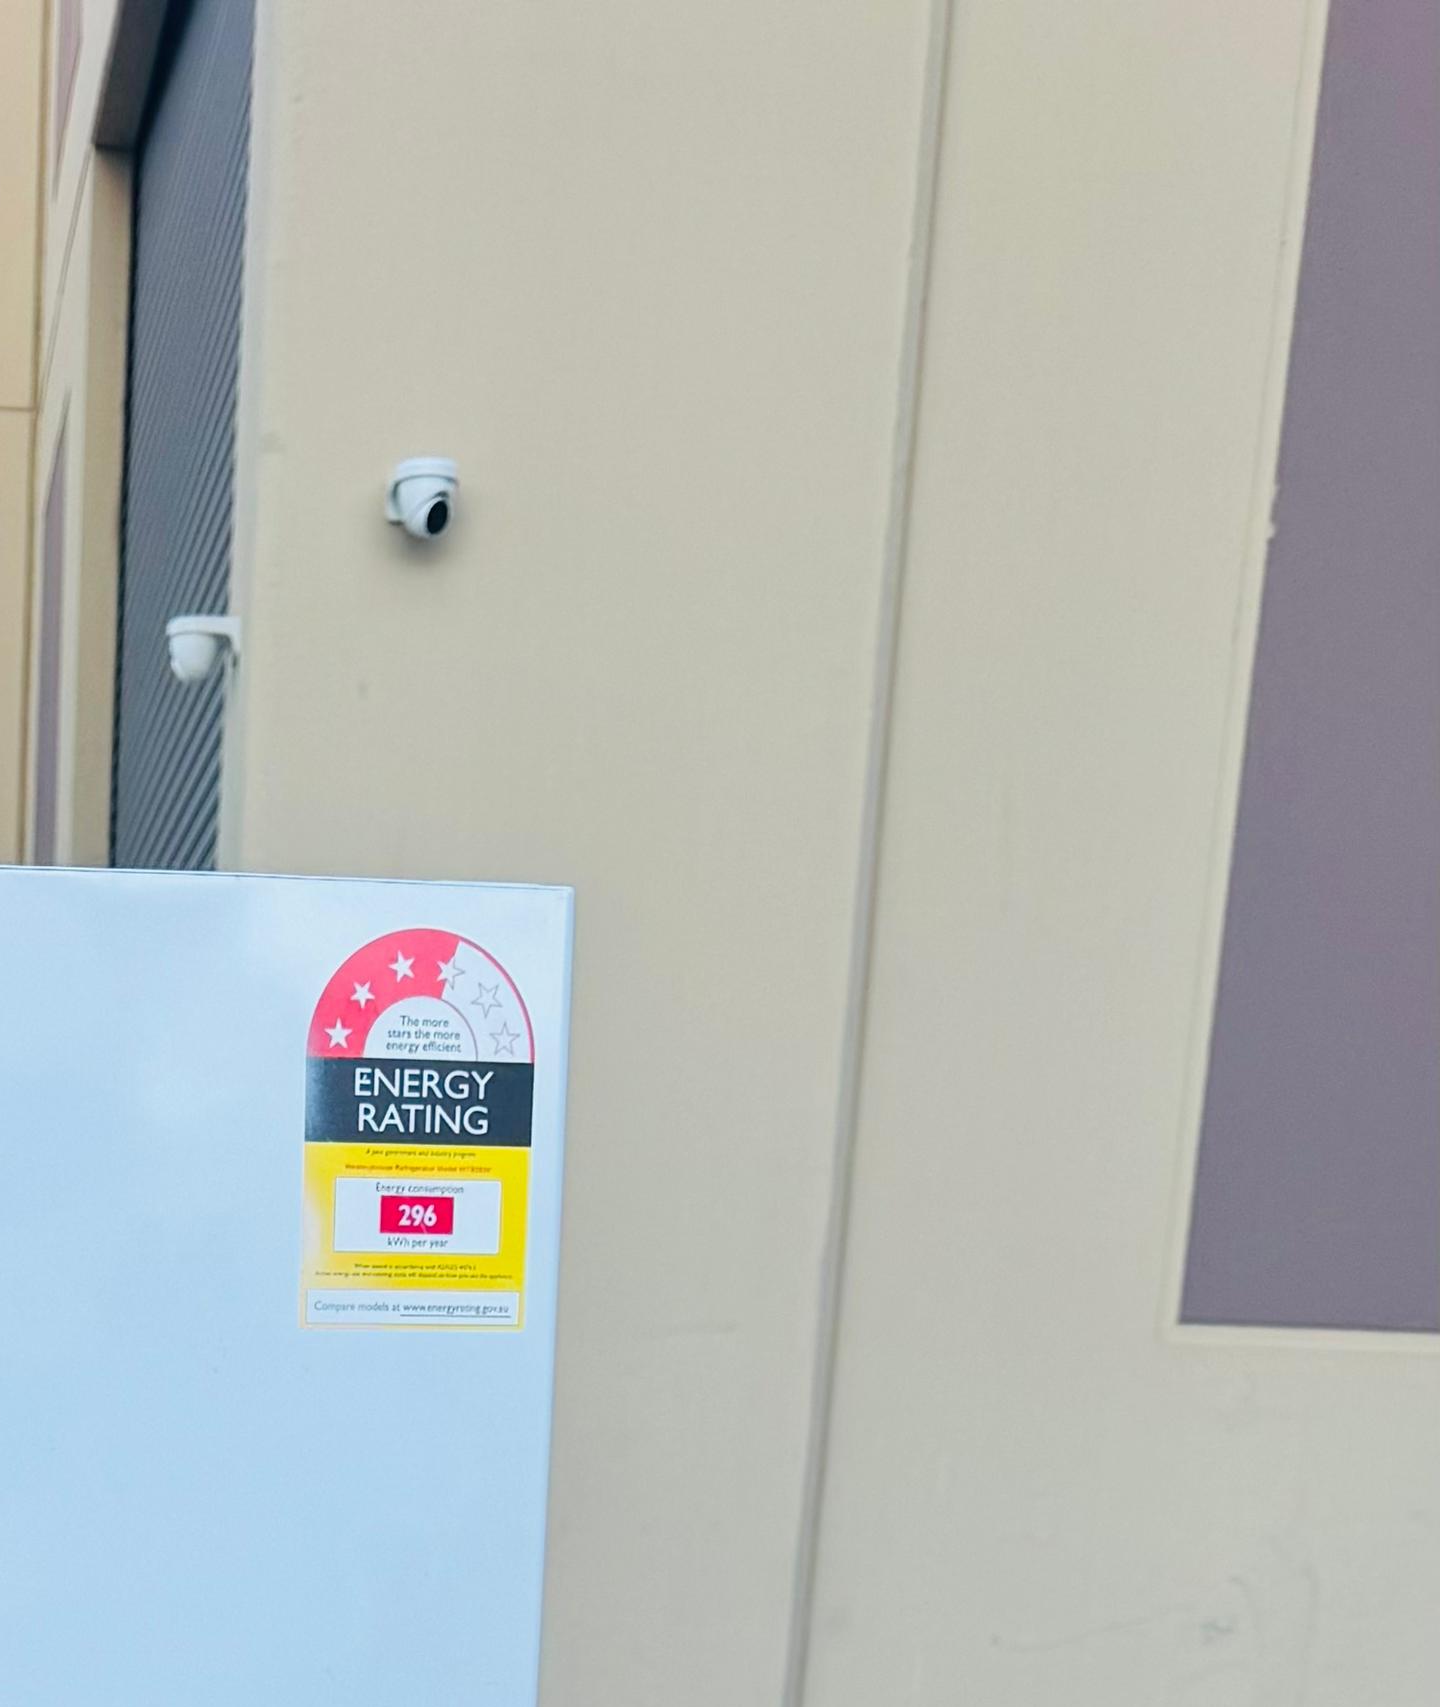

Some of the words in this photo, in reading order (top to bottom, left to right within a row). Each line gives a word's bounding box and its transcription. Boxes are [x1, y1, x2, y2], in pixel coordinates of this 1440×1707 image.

[399, 1015, 420, 1027] The
[422, 1019, 449, 1028] more
[387, 1029, 411, 1039] stars
[414, 1028, 431, 1039] the
[433, 1031, 461, 1041] more
[386, 1042, 420, 1054] energy
[422, 1041, 462, 1053] efficient
[354, 1067, 494, 1100] ENERGY
[358, 1103, 489, 1135] RATING
[376, 1182, 406, 1195] Energy
[407, 1184, 465, 1195] consumption
[397, 1203, 438, 1227] 296
[411, 1239, 427, 1249] per
[428, 1239, 449, 1249] year
[313, 1300, 356, 1313] Compare
[357, 1302, 390, 1312] models
[391, 1303, 401, 1312] at
